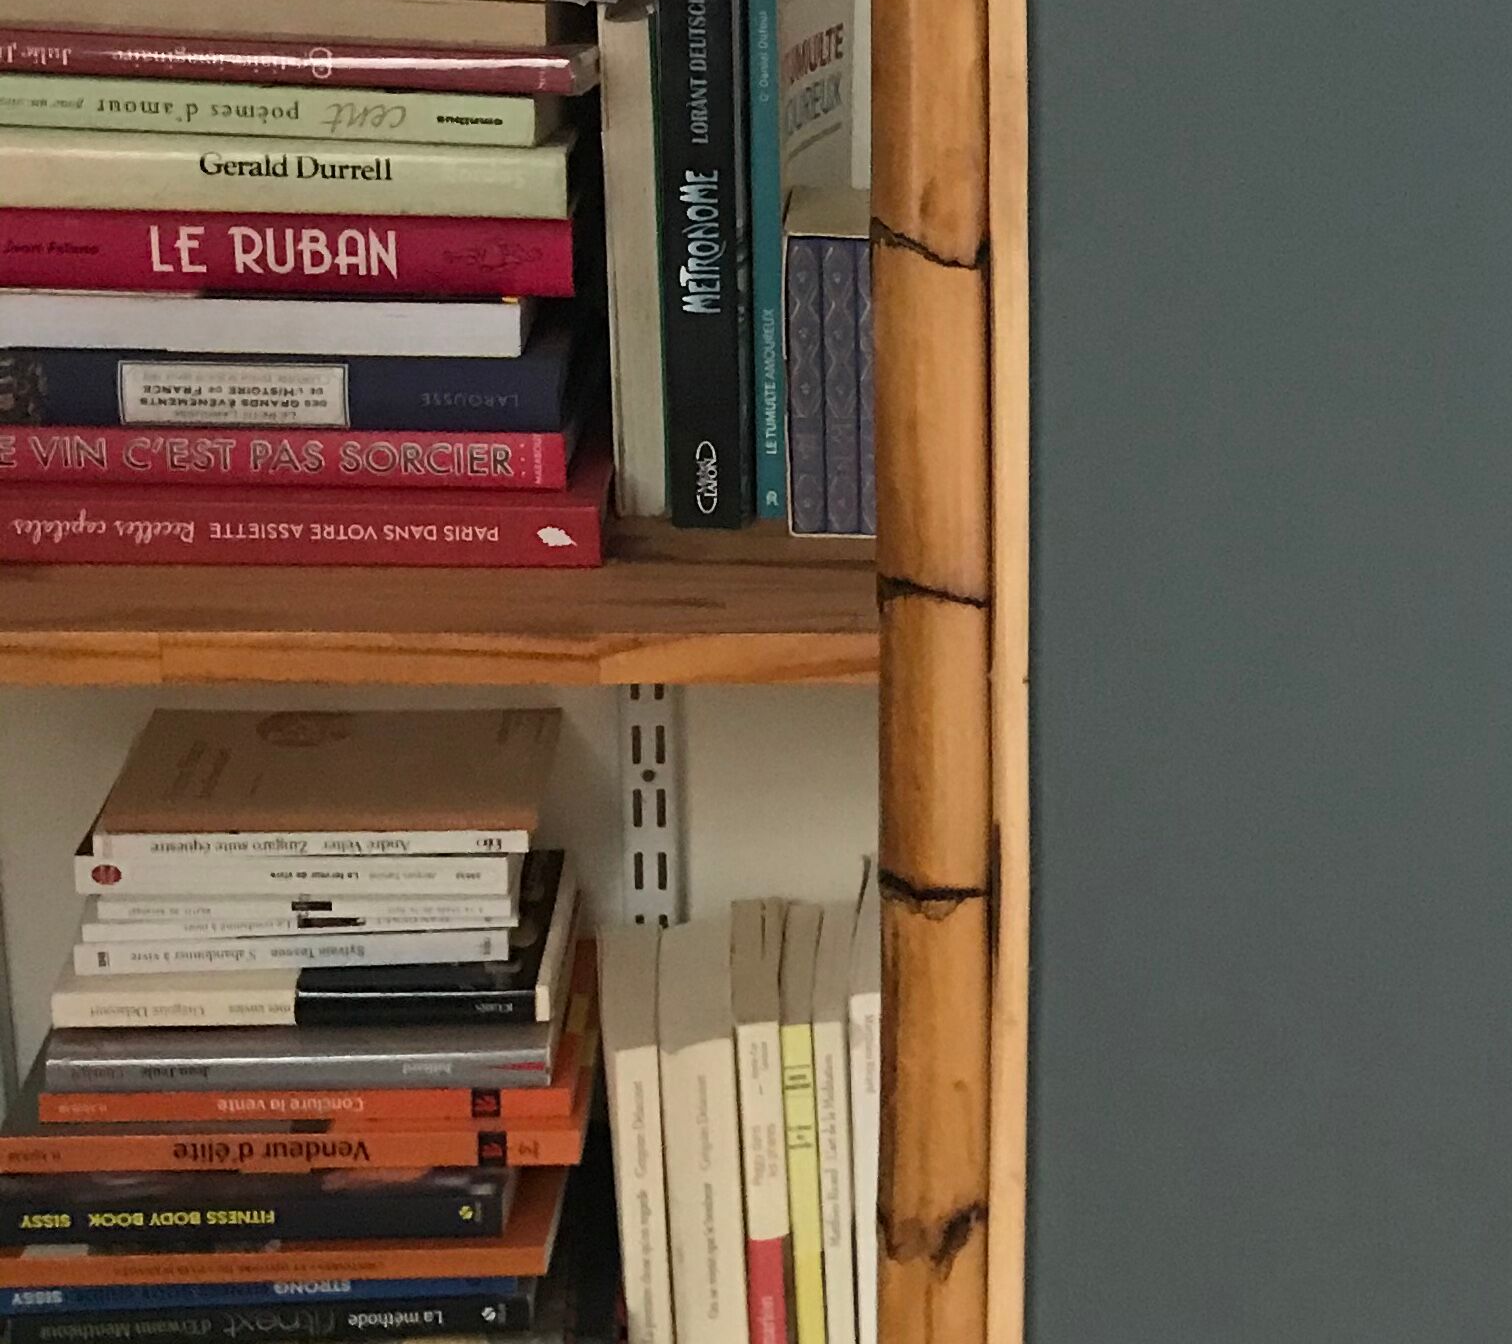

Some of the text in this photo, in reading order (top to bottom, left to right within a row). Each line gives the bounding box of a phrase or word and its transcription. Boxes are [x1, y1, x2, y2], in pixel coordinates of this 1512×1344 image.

[96, 98, 200, 123] d'amour
[210, 100, 300, 124] poèmes
[320, 101, 407, 134] cent
[199, 151, 393, 182] Gerald Durrell
[150, 224, 208, 273] LE
[228, 225, 398, 281] RUBAN
[142, 384, 202, 397] FRANCE
[421, 392, 518, 408] LAROUSSE
[240, 398, 301, 409] GRANDS
[764, 382, 778, 439] TUMULTE
[28, 434, 515, 477] VIN C'EST PAS SORCIER
[11, 508, 500, 545] PARIS DANS VOTRE ASSIETTE Recettes capitales
[150, 838, 212, 855] équestre
[216, 838, 249, 852] suite
[252, 838, 309, 854] Zingaro
[130, 951, 160, 962] vivre
[216, 1096, 365, 1113] Conclure la vente
[172, 1139, 371, 1164] Vendeur d'élite
[19, 1210, 276, 1229] FITNESS BODY BOOK SISSY
[11, 1281, 352, 1305] STRONG SISSY
[347, 1312, 421, 1329] méthode
[423, 1309, 444, 1325] La
